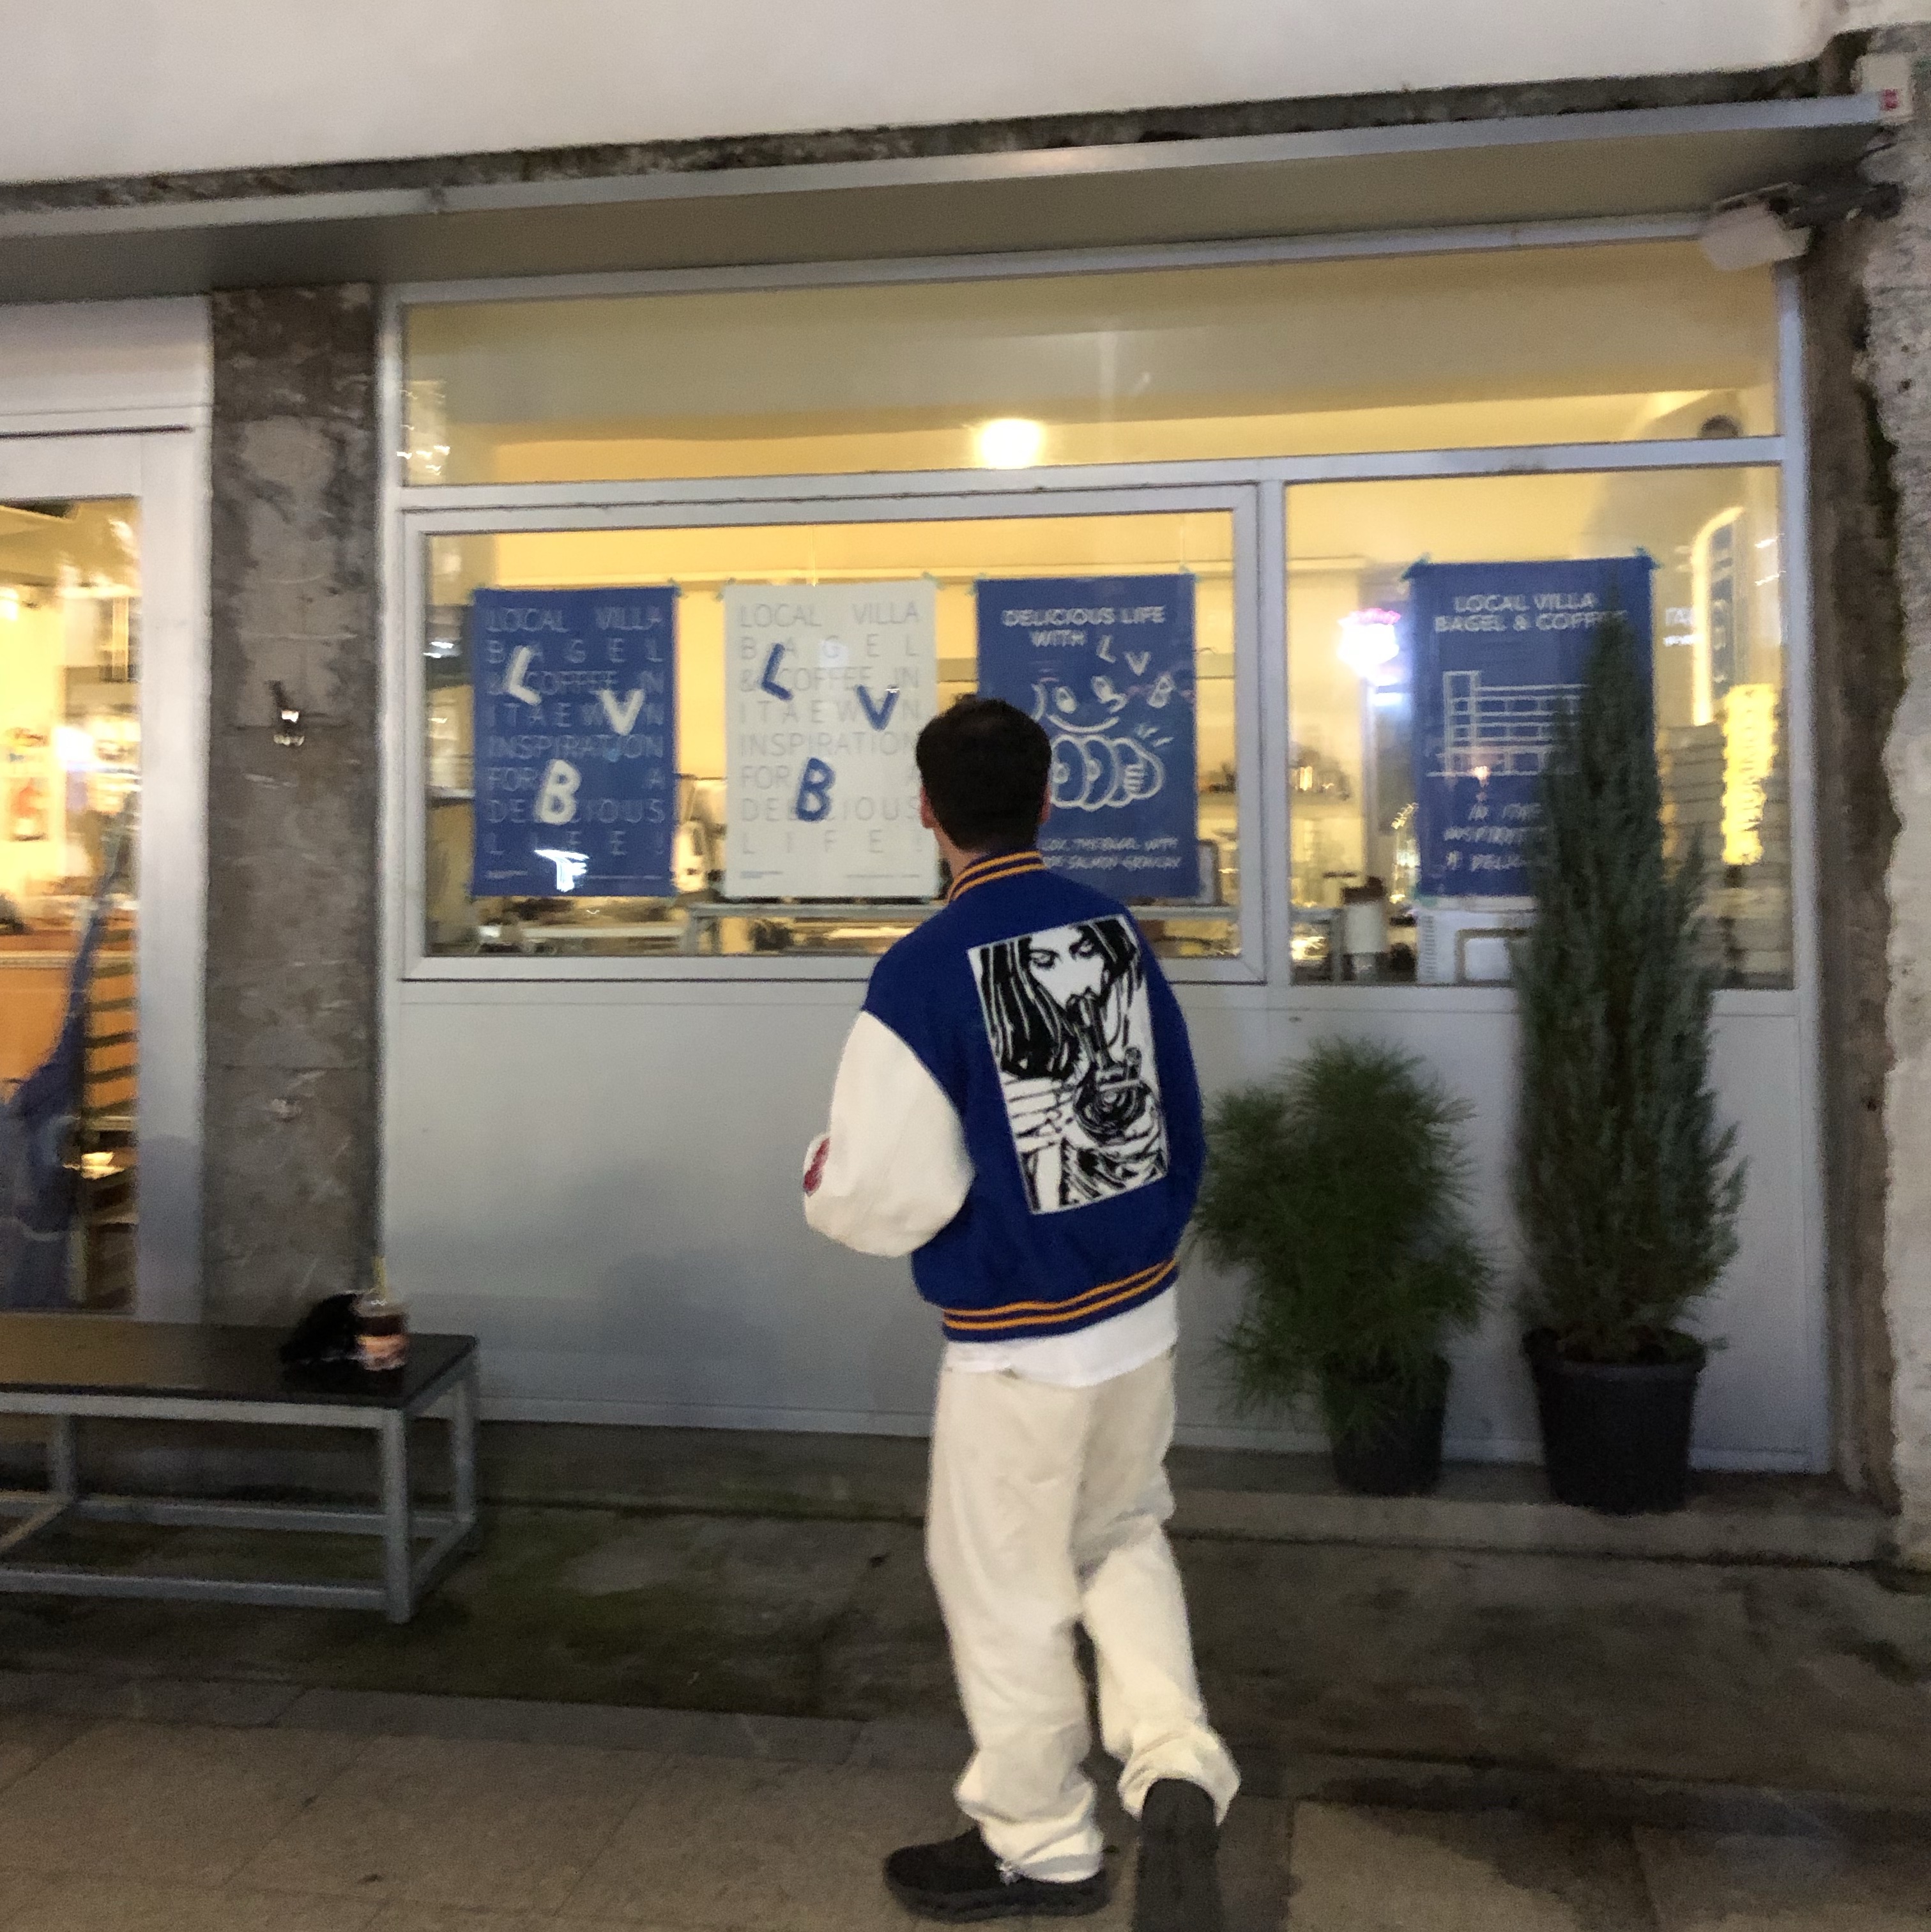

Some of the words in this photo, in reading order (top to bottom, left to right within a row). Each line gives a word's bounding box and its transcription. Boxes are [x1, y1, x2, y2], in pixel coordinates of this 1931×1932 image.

[740, 604, 822, 628] LOCAL
[852, 601, 919, 625] VILLA
[1453, 594, 1530, 612] LOCAL
[1533, 592, 1598, 611] VILLA
[486, 607, 569, 633] LOCAL
[595, 607, 663, 630] VILLA
[1002, 607, 1114, 627] DELICIOUS
[1120, 605, 1166, 624] LIFE
[1435, 615, 1507, 632] BAGEL
[1513, 614, 1528, 632] &
[1536, 610, 1628, 630] COFF
[1028, 629, 1087, 647] WITH
[740, 699, 920, 724] ITAEWN
[740, 731, 918, 757] INSPIRATION
[740, 764, 791, 789] FOR
